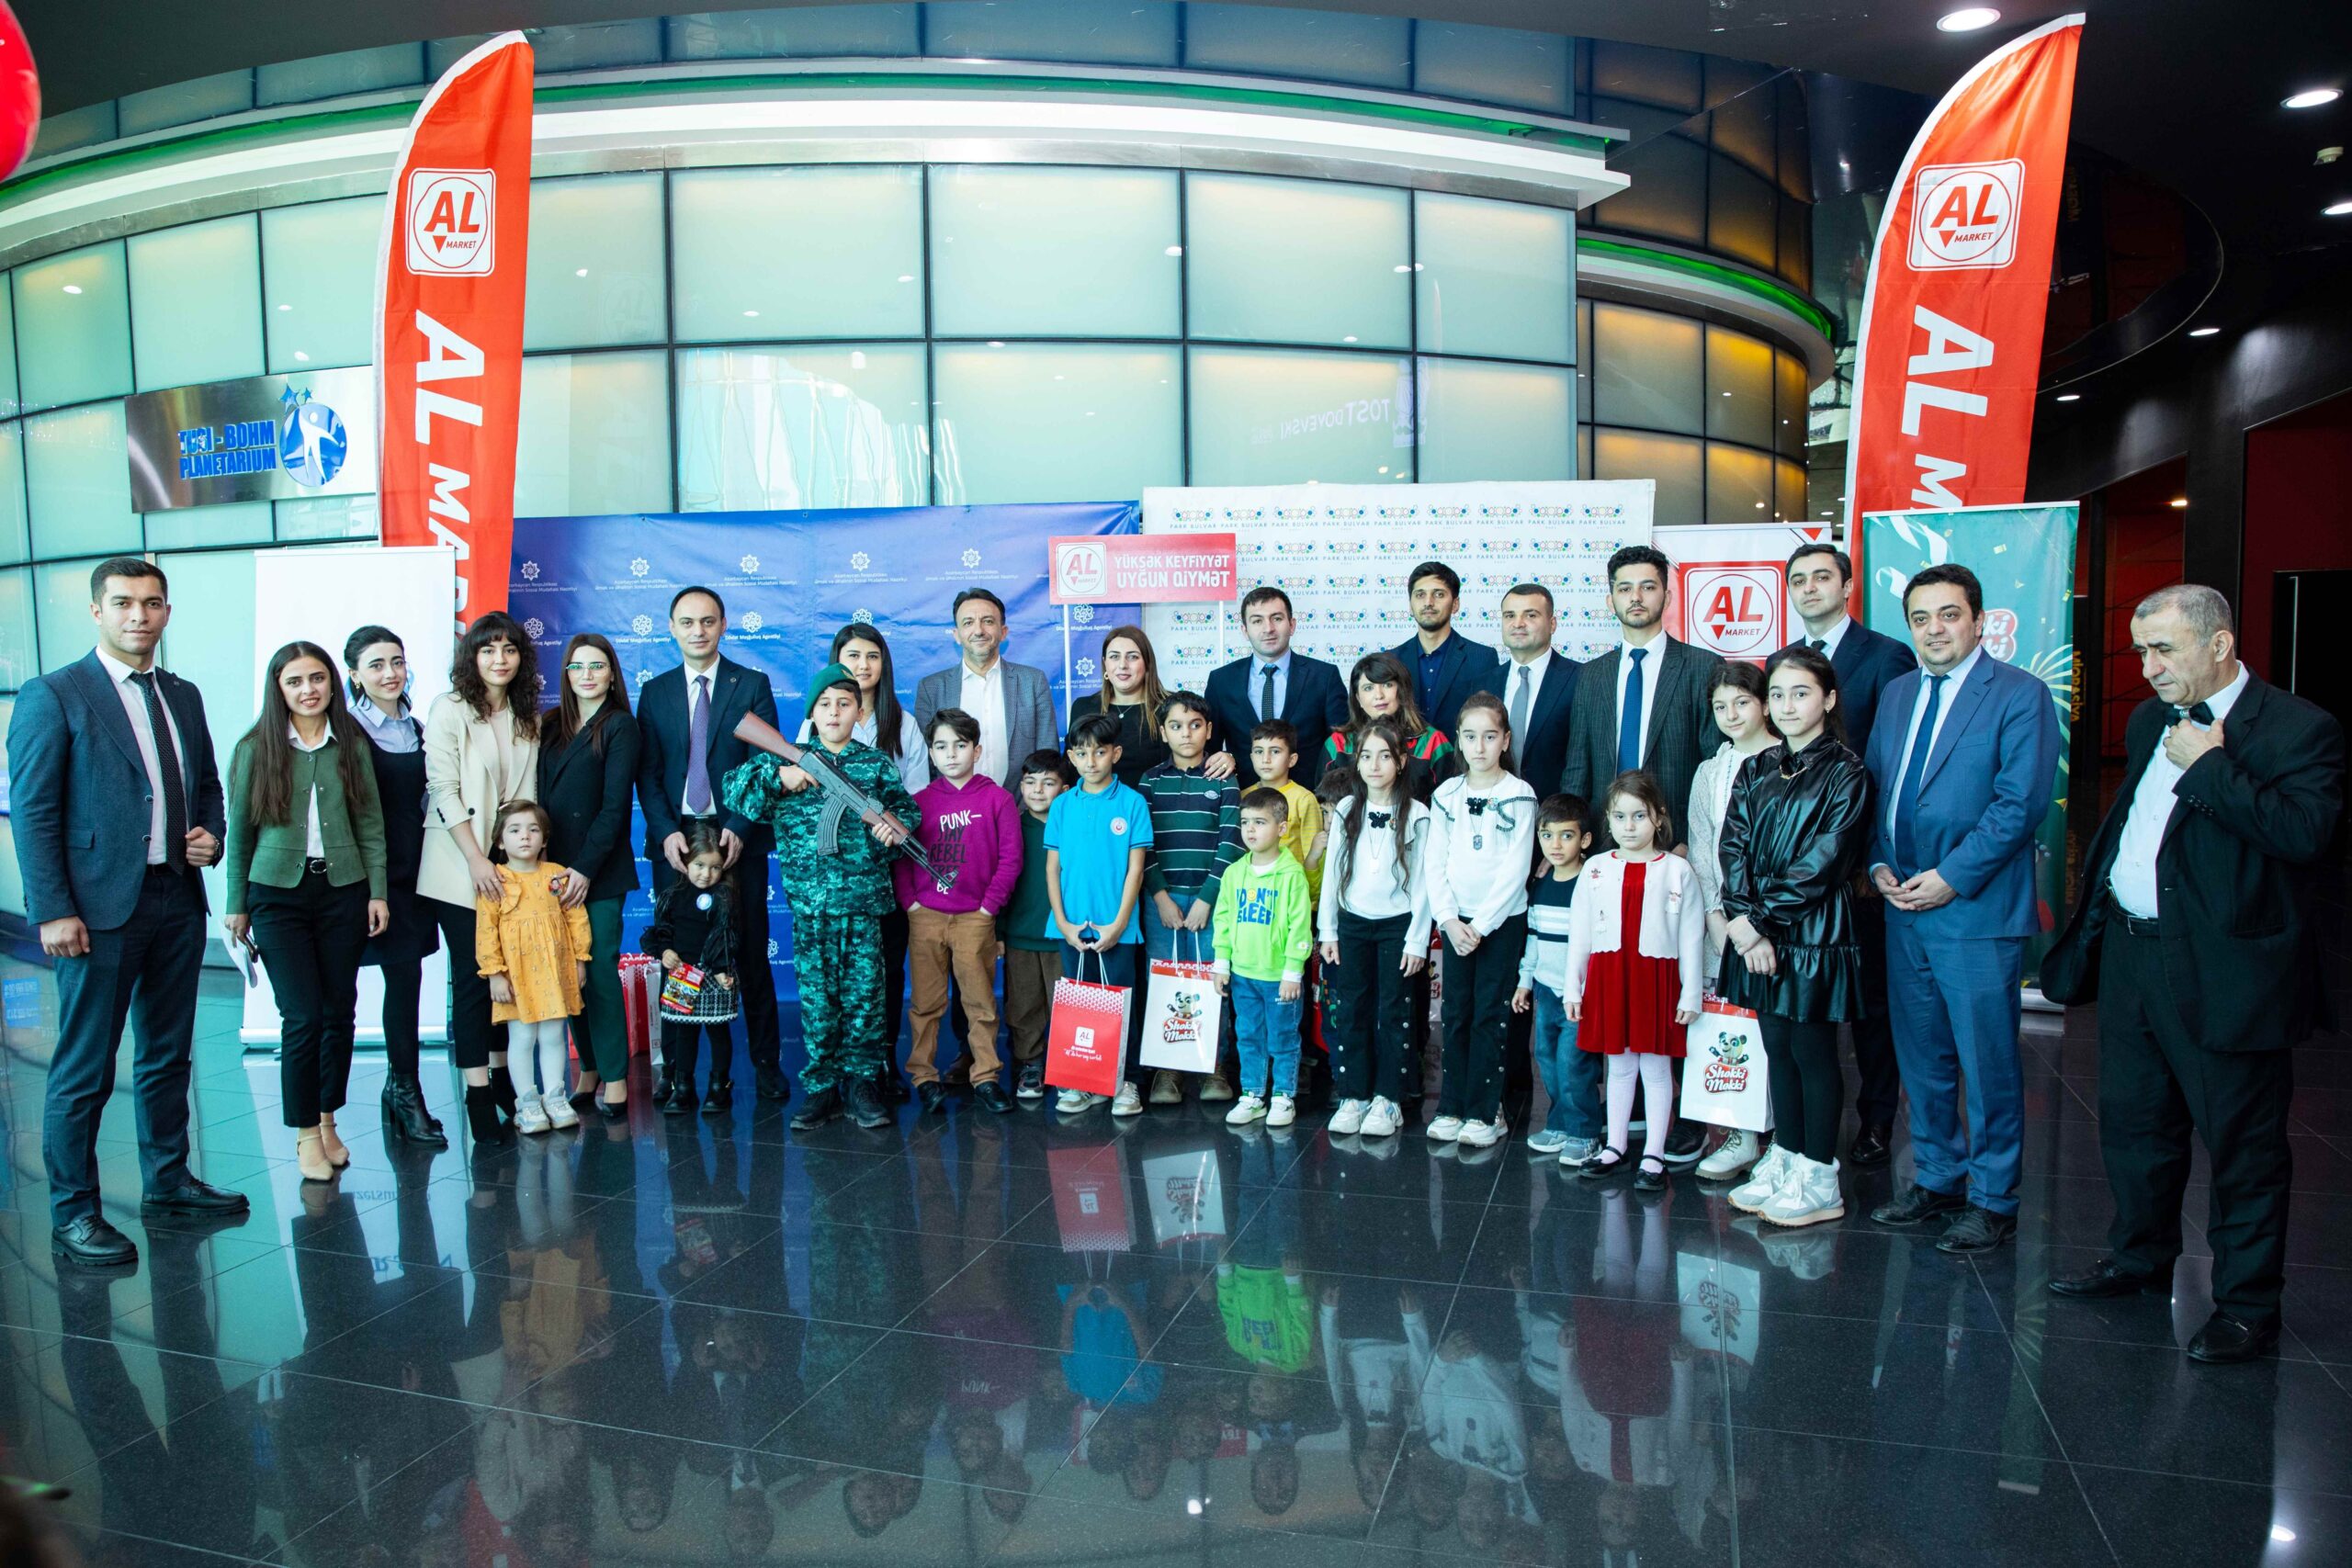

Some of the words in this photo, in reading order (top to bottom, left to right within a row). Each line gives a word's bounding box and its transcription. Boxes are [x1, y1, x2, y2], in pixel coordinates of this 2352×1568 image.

[424, 191, 481, 233] AL
[1930, 184, 1999, 228] AL
[446, 241, 477, 249] MARKET
[1954, 231, 1994, 243] MARKET
[414, 309, 485, 445] AL
[1901, 304, 1995, 436] AL
[224, 420, 277, 449] BOHM
[179, 447, 277, 479] PLANETARIUM
[1066, 553, 1098, 575] AL
[1702, 586, 1764, 622] AL
[930, 842, 968, 863] REBEL
[1706, 1065, 1747, 1079] Shokki
[1706, 1078, 1745, 1091] Mokki
